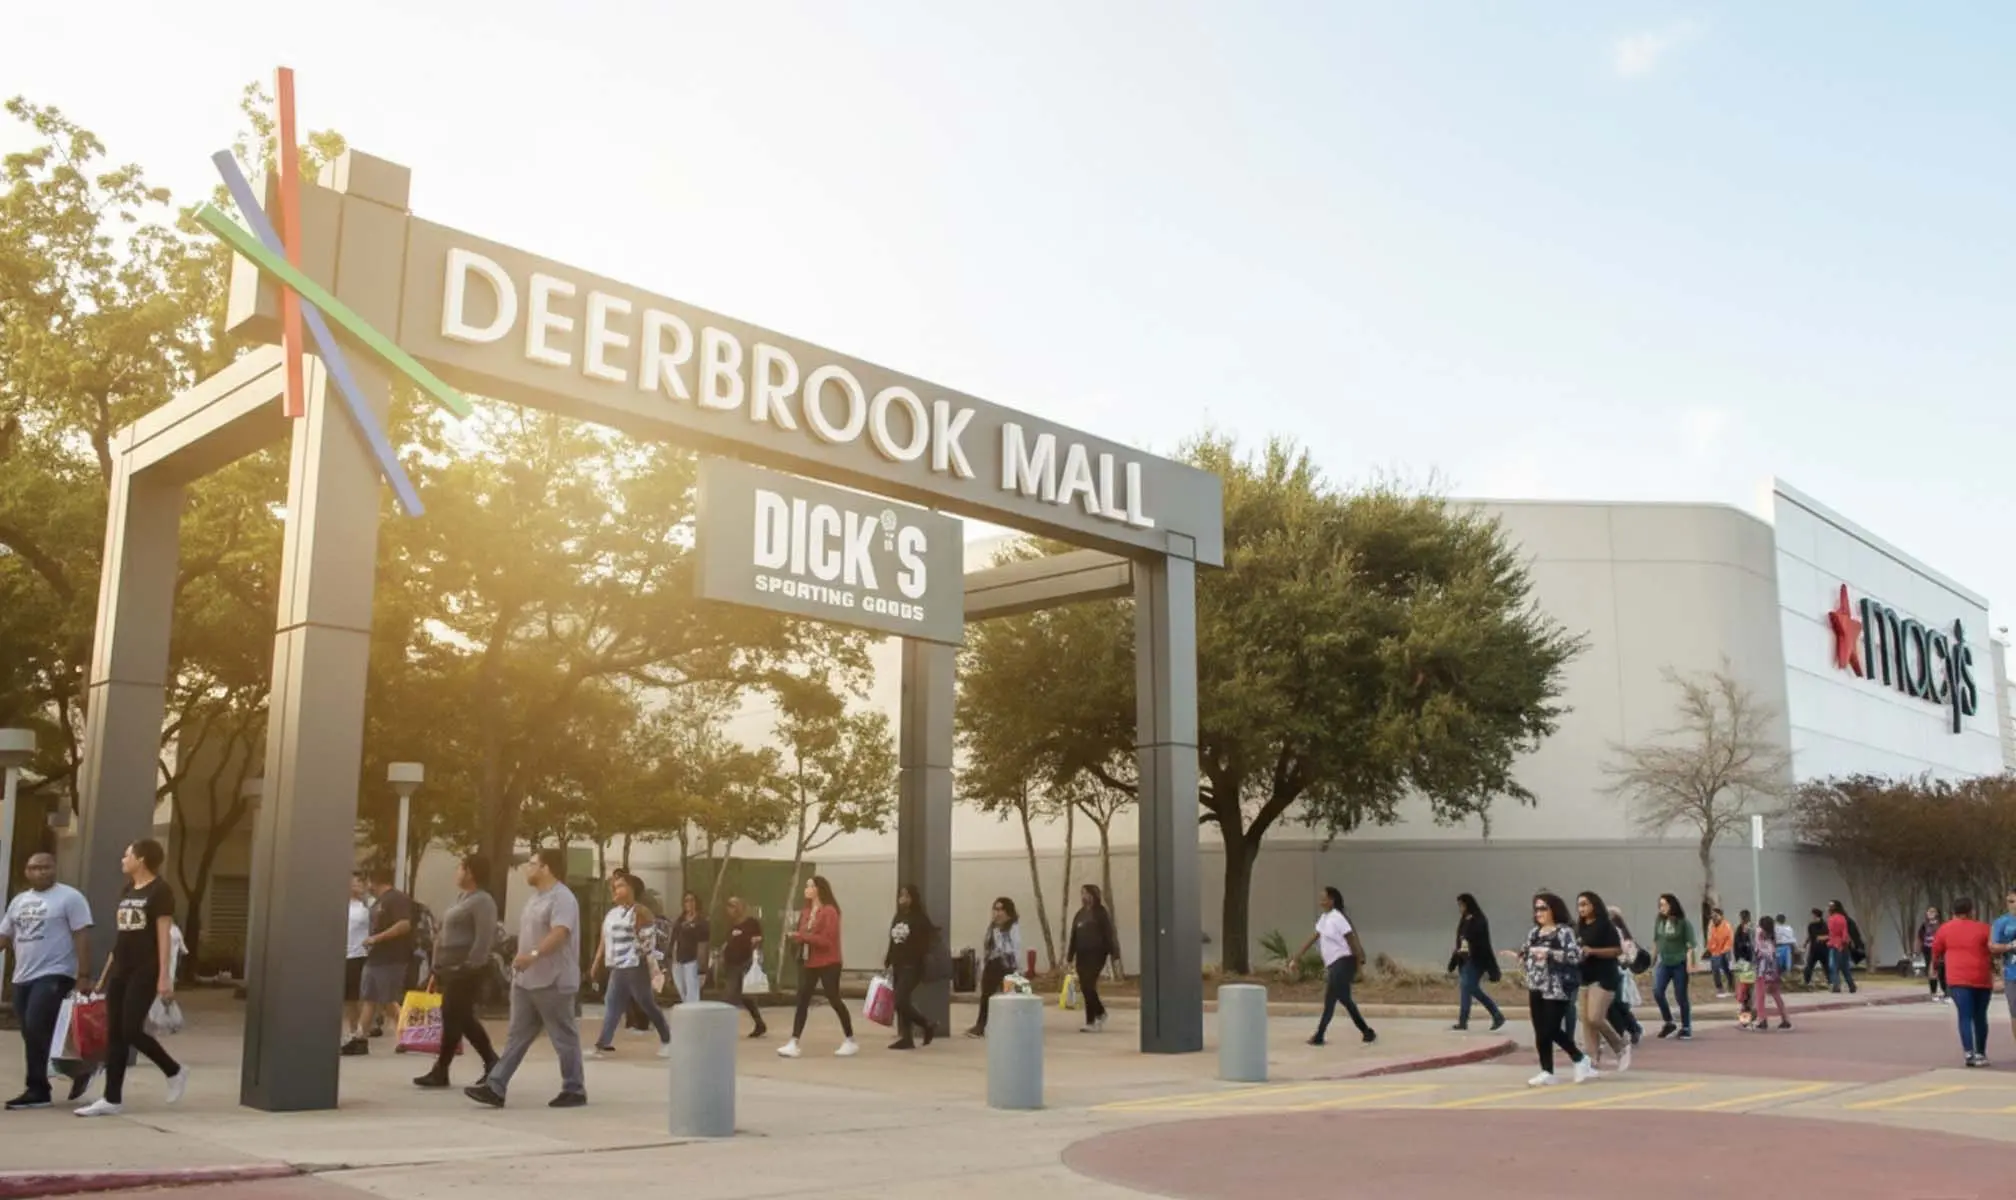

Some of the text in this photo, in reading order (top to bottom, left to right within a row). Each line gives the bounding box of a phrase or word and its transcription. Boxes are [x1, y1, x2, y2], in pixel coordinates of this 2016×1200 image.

[441, 247, 1155, 528] DEERBROOK MALL
[753, 488, 927, 599] DICK'S
[755, 574, 925, 622] SPORTING GOODS
[1860, 597, 1977, 734] macy's
